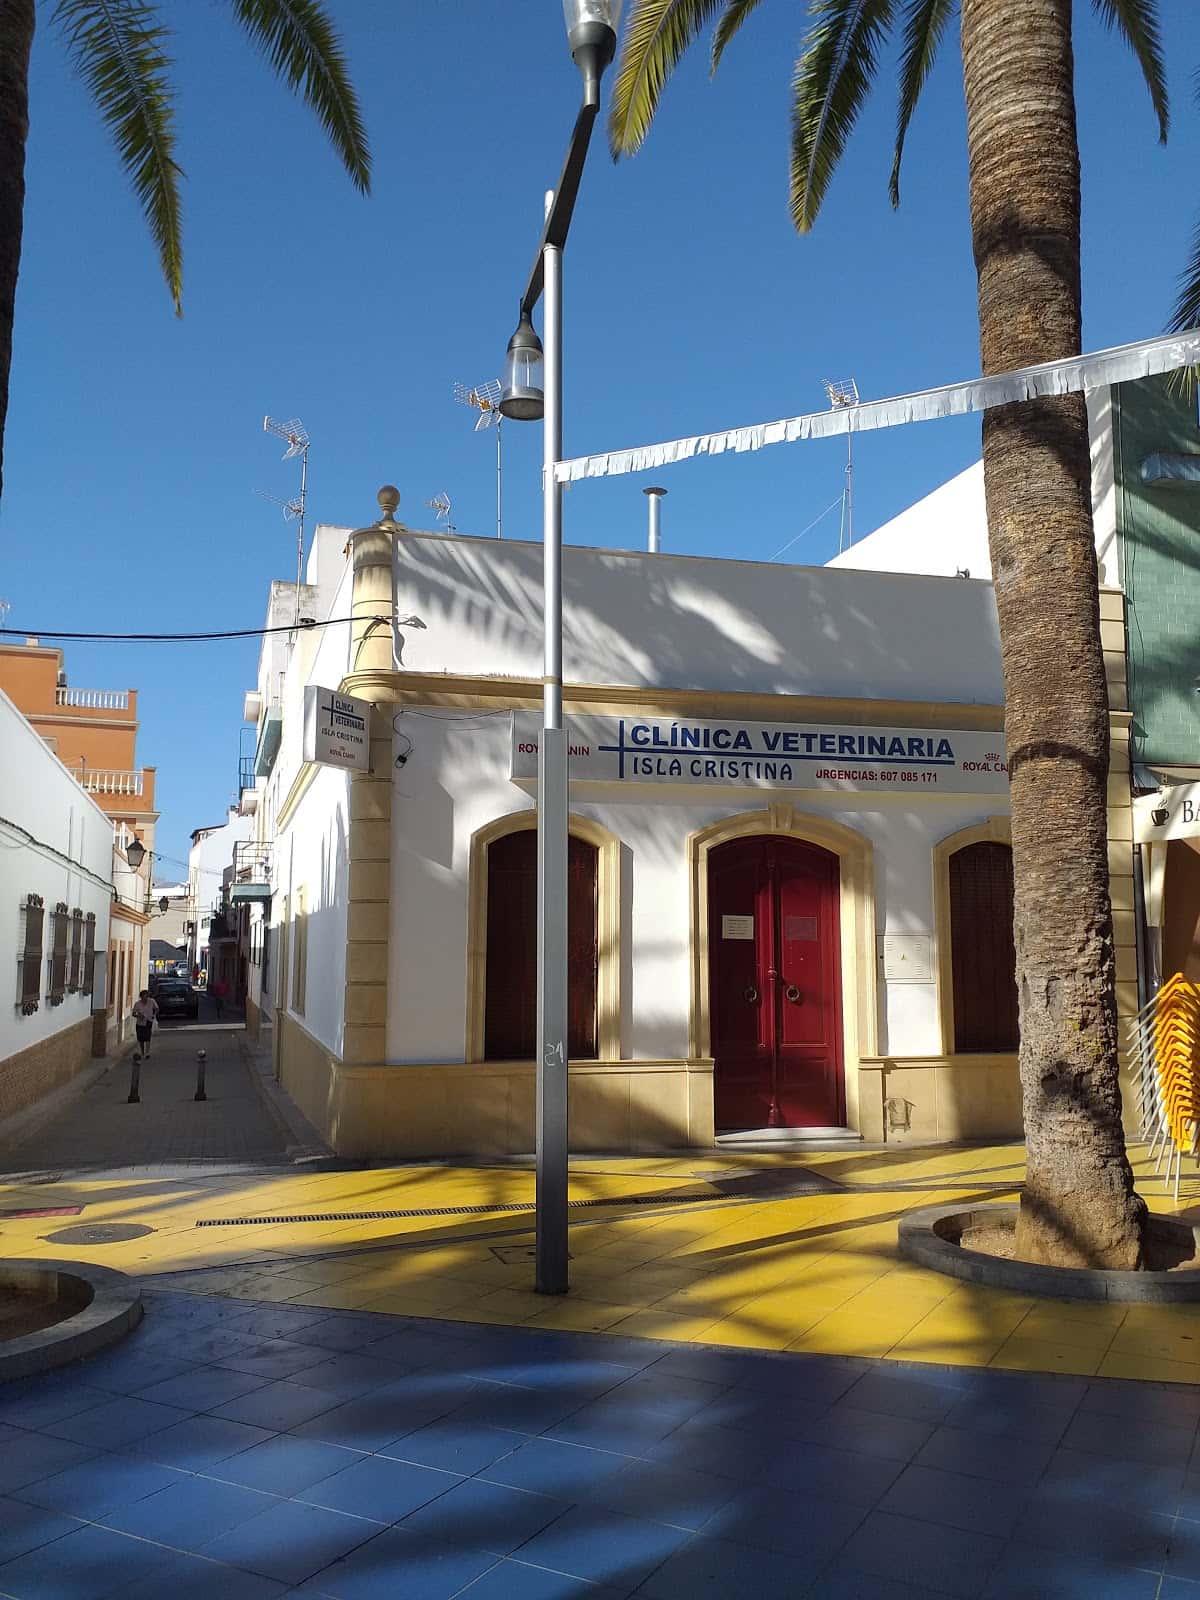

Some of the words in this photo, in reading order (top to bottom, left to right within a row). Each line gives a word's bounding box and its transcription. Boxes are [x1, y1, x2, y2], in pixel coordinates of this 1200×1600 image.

[321, 728, 335, 738] ISLA
[336, 731, 363, 744] CRISTINA
[631, 722, 753, 750] CLÍNICA
[761, 731, 955, 758] VETERINARIA
[518, 743, 539, 754] ROY
[568, 745, 590, 756] NIN
[633, 757, 682, 777] ISLA
[690, 759, 793, 781] CRISTINA
[962, 761, 992, 772] ROYAL
[816, 769, 878, 781] URGENCIAS:
[880, 770, 898, 781] 607
[901, 771, 919, 782] 085
[921, 772, 938, 782] 171
